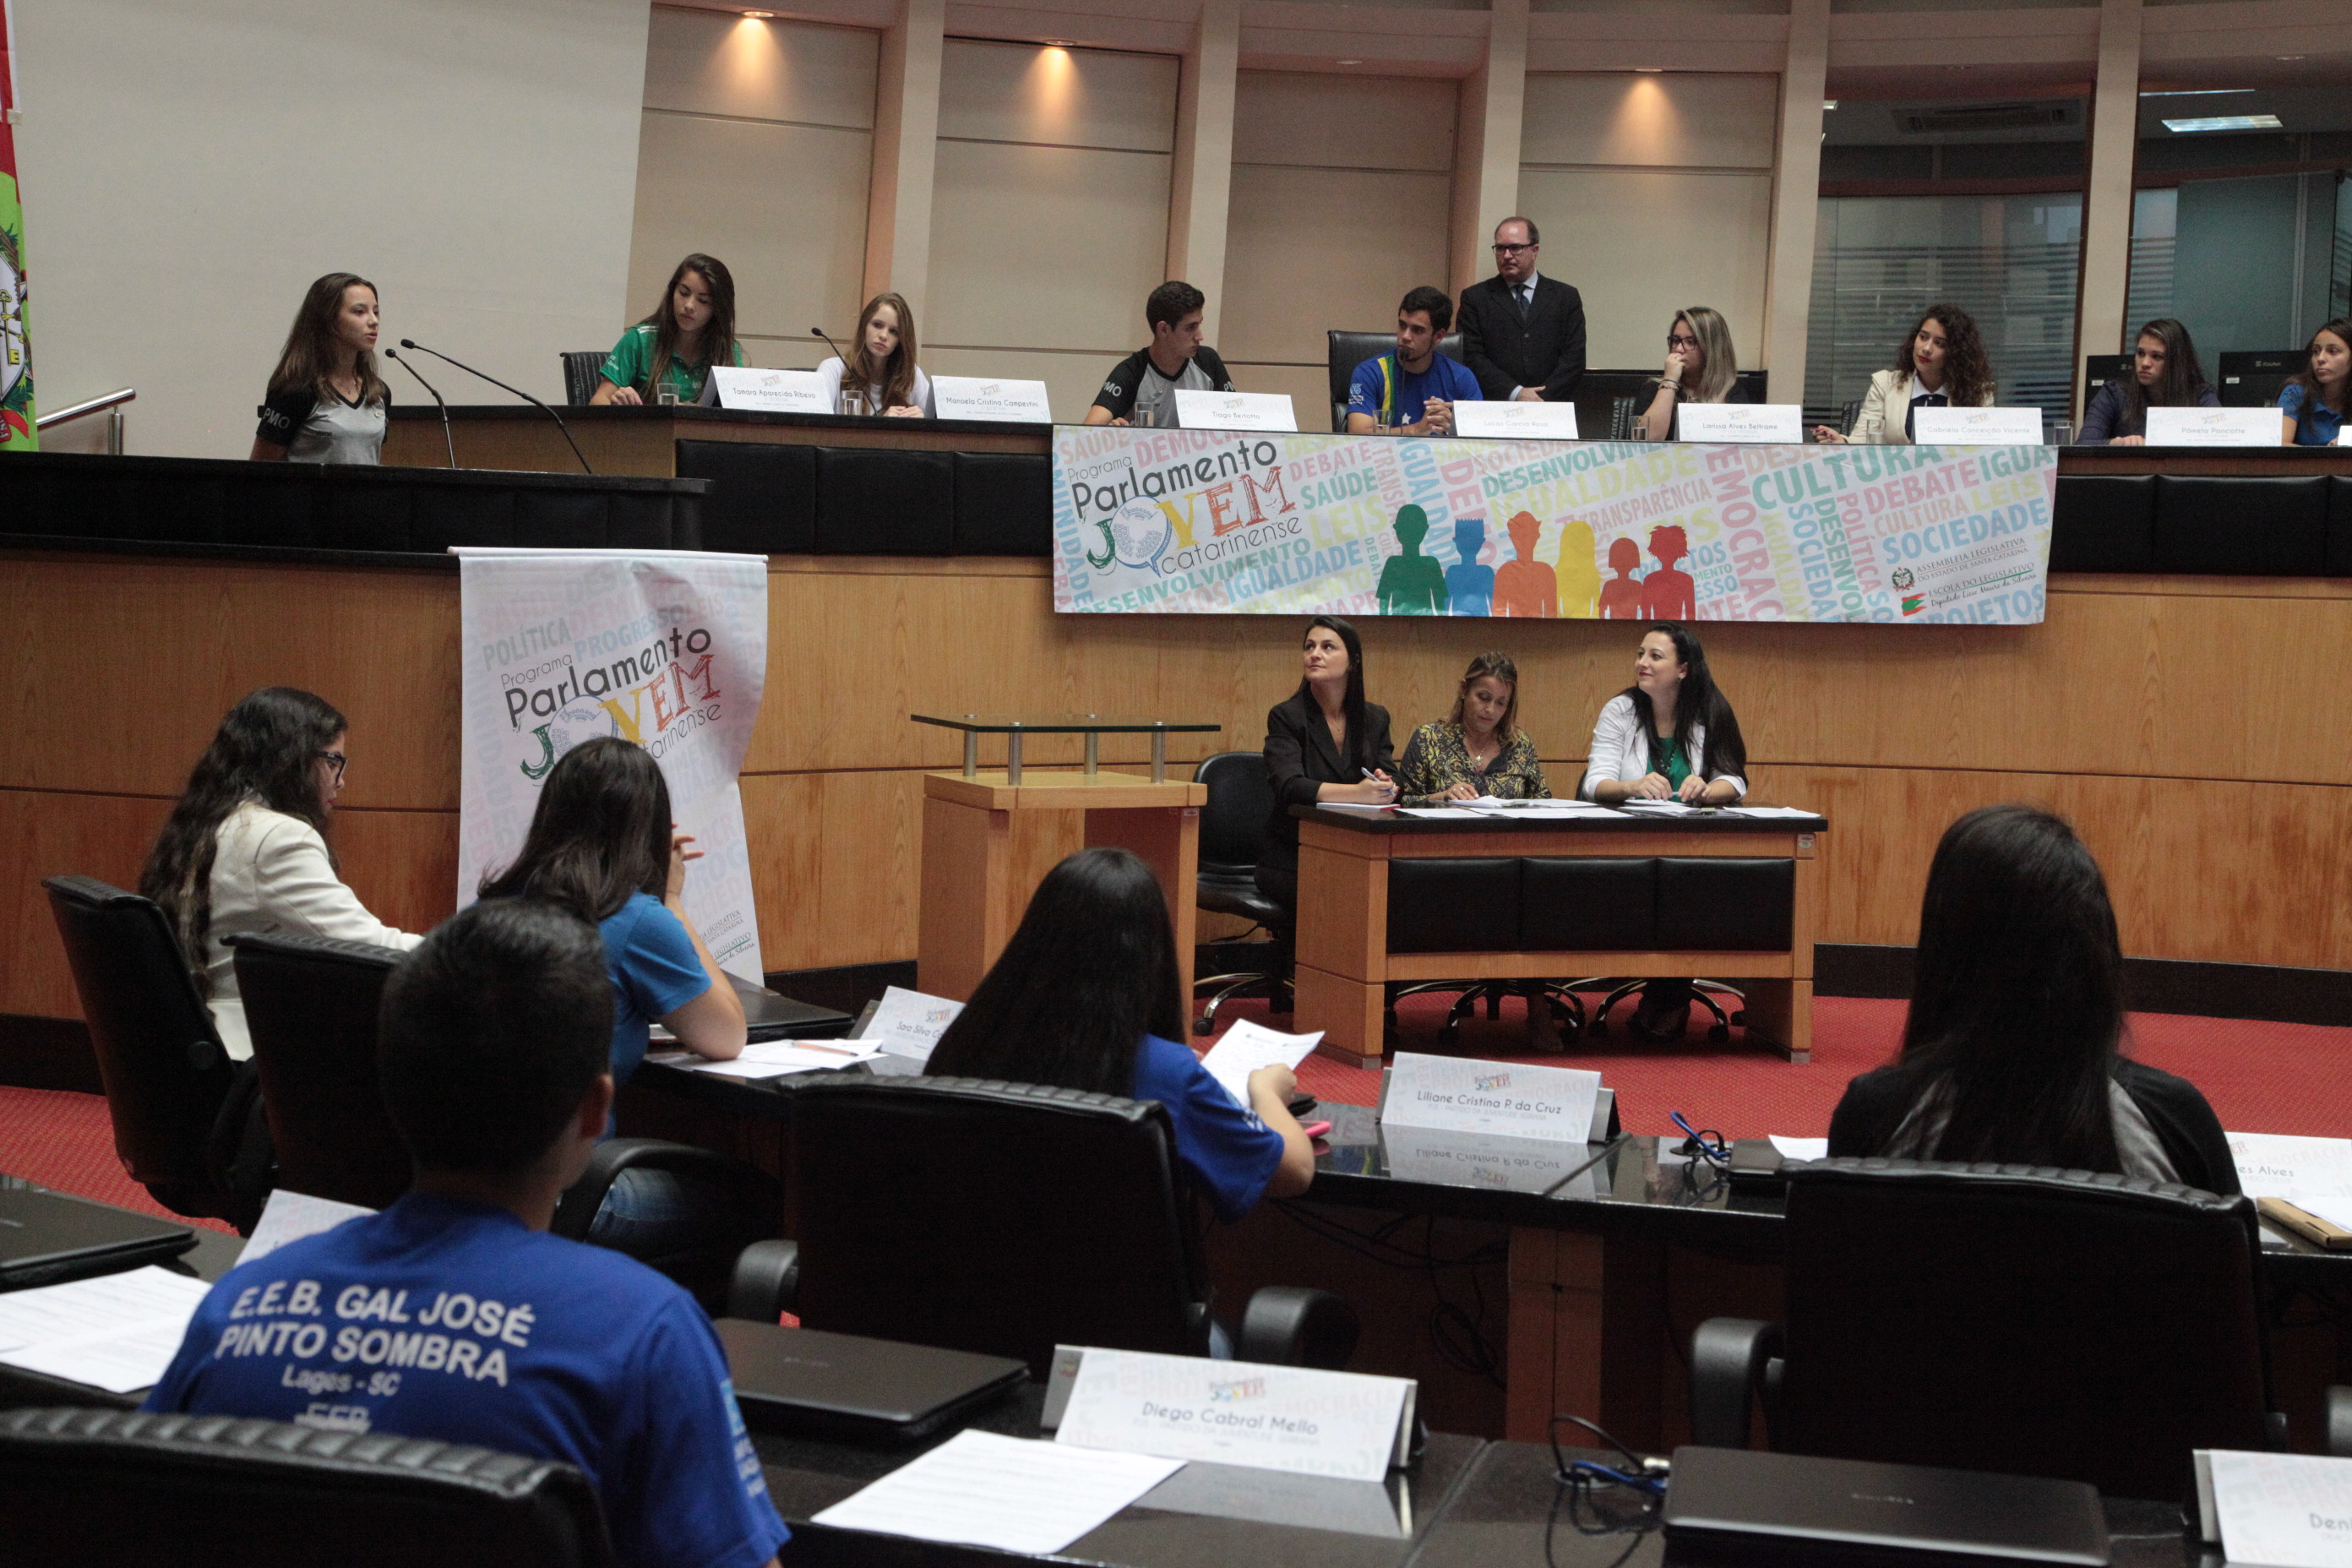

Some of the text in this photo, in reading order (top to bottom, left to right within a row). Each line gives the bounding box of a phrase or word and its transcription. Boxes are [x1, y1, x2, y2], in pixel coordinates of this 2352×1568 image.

[732, 387, 816, 399] Tamara Aparecida Ribeiro
[1004, 399, 1039, 408] Campestini
[1103, 381, 1122, 397] MO
[263, 407, 291, 429] PMO
[1211, 411, 1232, 419] Tiago
[1067, 455, 1133, 482] Programa
[1071, 439, 1277, 520] Parlamento
[1288, 441, 1373, 482] DEBATE
[1752, 445, 1942, 510] CULTURA
[1300, 467, 1379, 510] SAÚDE
[1864, 459, 1980, 515] DEBATE
[1970, 473, 2042, 512] LEIS
[1086, 466, 1297, 577] JOVEM
[1308, 494, 1390, 549] LEIS
[1873, 494, 1970, 537] CULTURA
[1882, 497, 2049, 565] SOCIEDADE
[1161, 516, 1303, 574] catarinense
[1916, 553, 1969, 574] ASSEMBLEIA
[1971, 537, 2026, 558] LEGISLATIVA
[1225, 539, 1364, 603] IGUALDADE
[1918, 574, 1930, 583] DO
[1931, 567, 1958, 579] ESTADO
[1970, 557, 1992, 569] SANTA
[1993, 547, 2028, 562] CATARINA
[1928, 562, 2034, 597] ESCOLA DO LEGISLATIVO
[499, 654, 573, 690] Programa
[505, 627, 712, 728] Parlamento
[1417, 1090, 1453, 1103] Liliane
[1457, 1094, 1501, 1108] Cristina
[1516, 1099, 1531, 1112] da
[1535, 1102, 1562, 1114] Cruz
[2258, 1166, 2295, 1177] Alves
[229, 1278, 537, 1349] E.E.B. GAL JOSÉ
[214, 1321, 329, 1359] PINTO
[331, 1325, 509, 1389] SOMBRA
[281, 1364, 353, 1396] Lages
[368, 1371, 402, 1397] SC
[1142, 1402, 1319, 1435] Diego Cabral Mello
